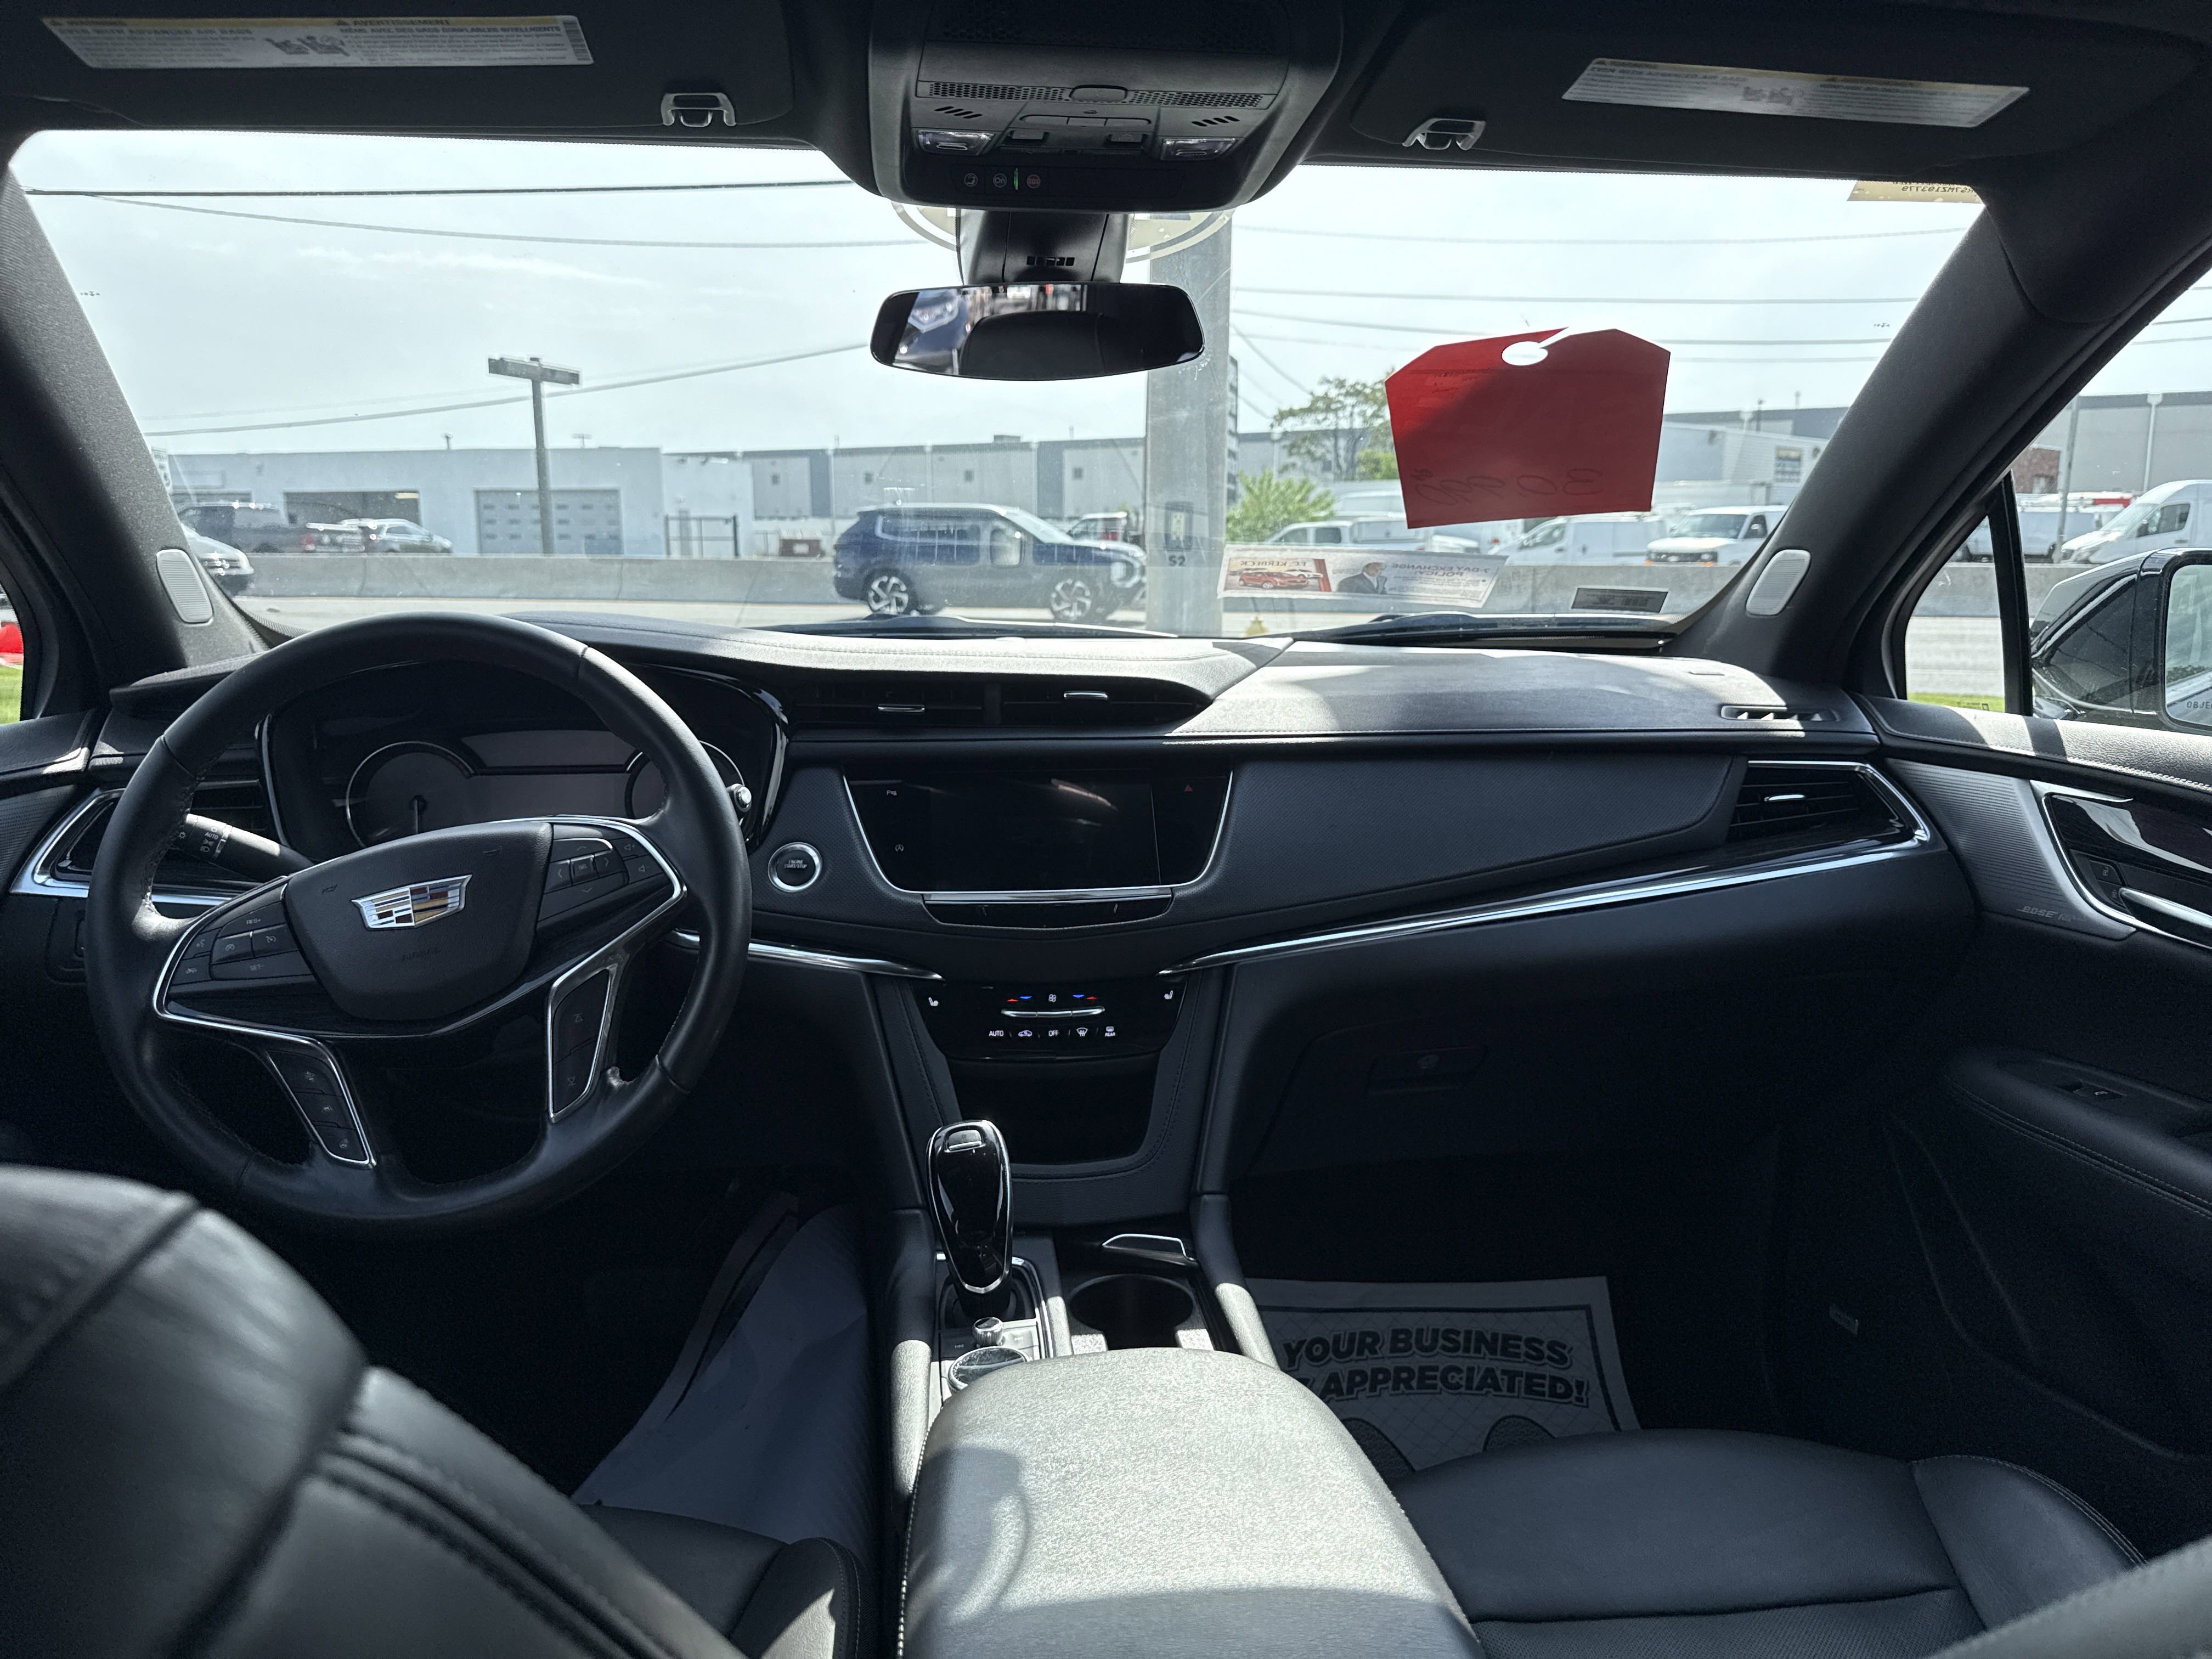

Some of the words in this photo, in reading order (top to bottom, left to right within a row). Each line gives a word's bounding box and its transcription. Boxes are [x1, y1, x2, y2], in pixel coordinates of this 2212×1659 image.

[1168, 555, 1186, 567] S2
[1283, 1330, 1380, 1368] YOUR
[1389, 1328, 1569, 1366] BUSINESS
[1321, 1364, 1585, 1402] APPRECIATED!
